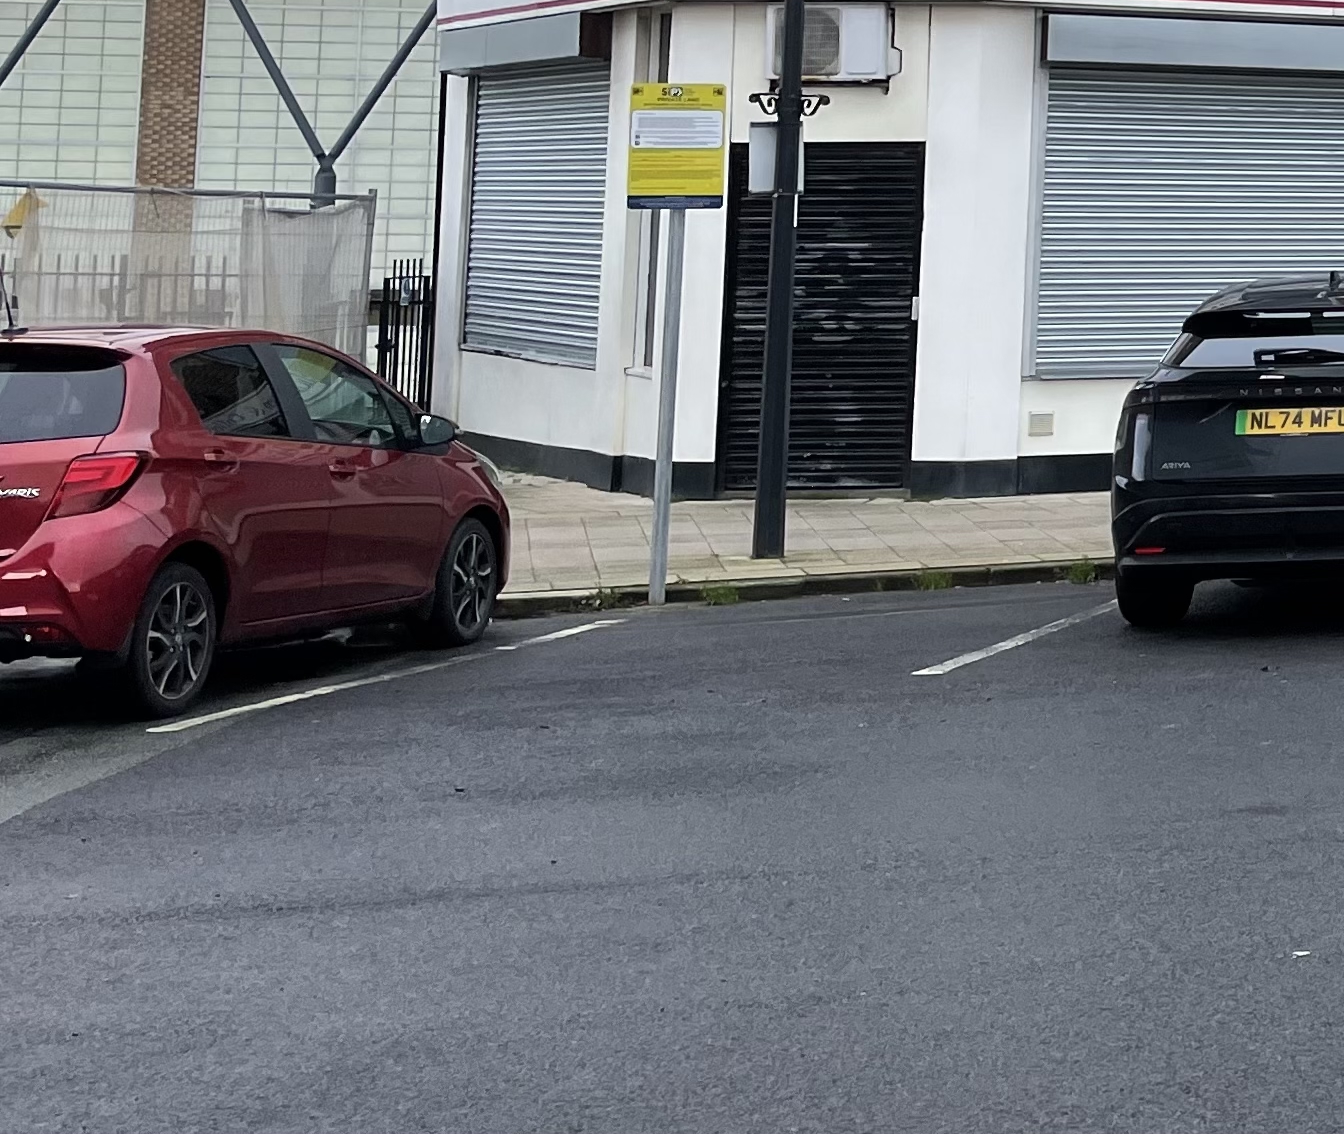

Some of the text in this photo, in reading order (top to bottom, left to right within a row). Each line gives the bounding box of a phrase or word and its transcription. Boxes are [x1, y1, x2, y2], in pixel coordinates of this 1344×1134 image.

[1239, 386, 1342, 395] NISSAN
[1250, 411, 1303, 430] NL74
[1160, 462, 1191, 470] ARIYA
